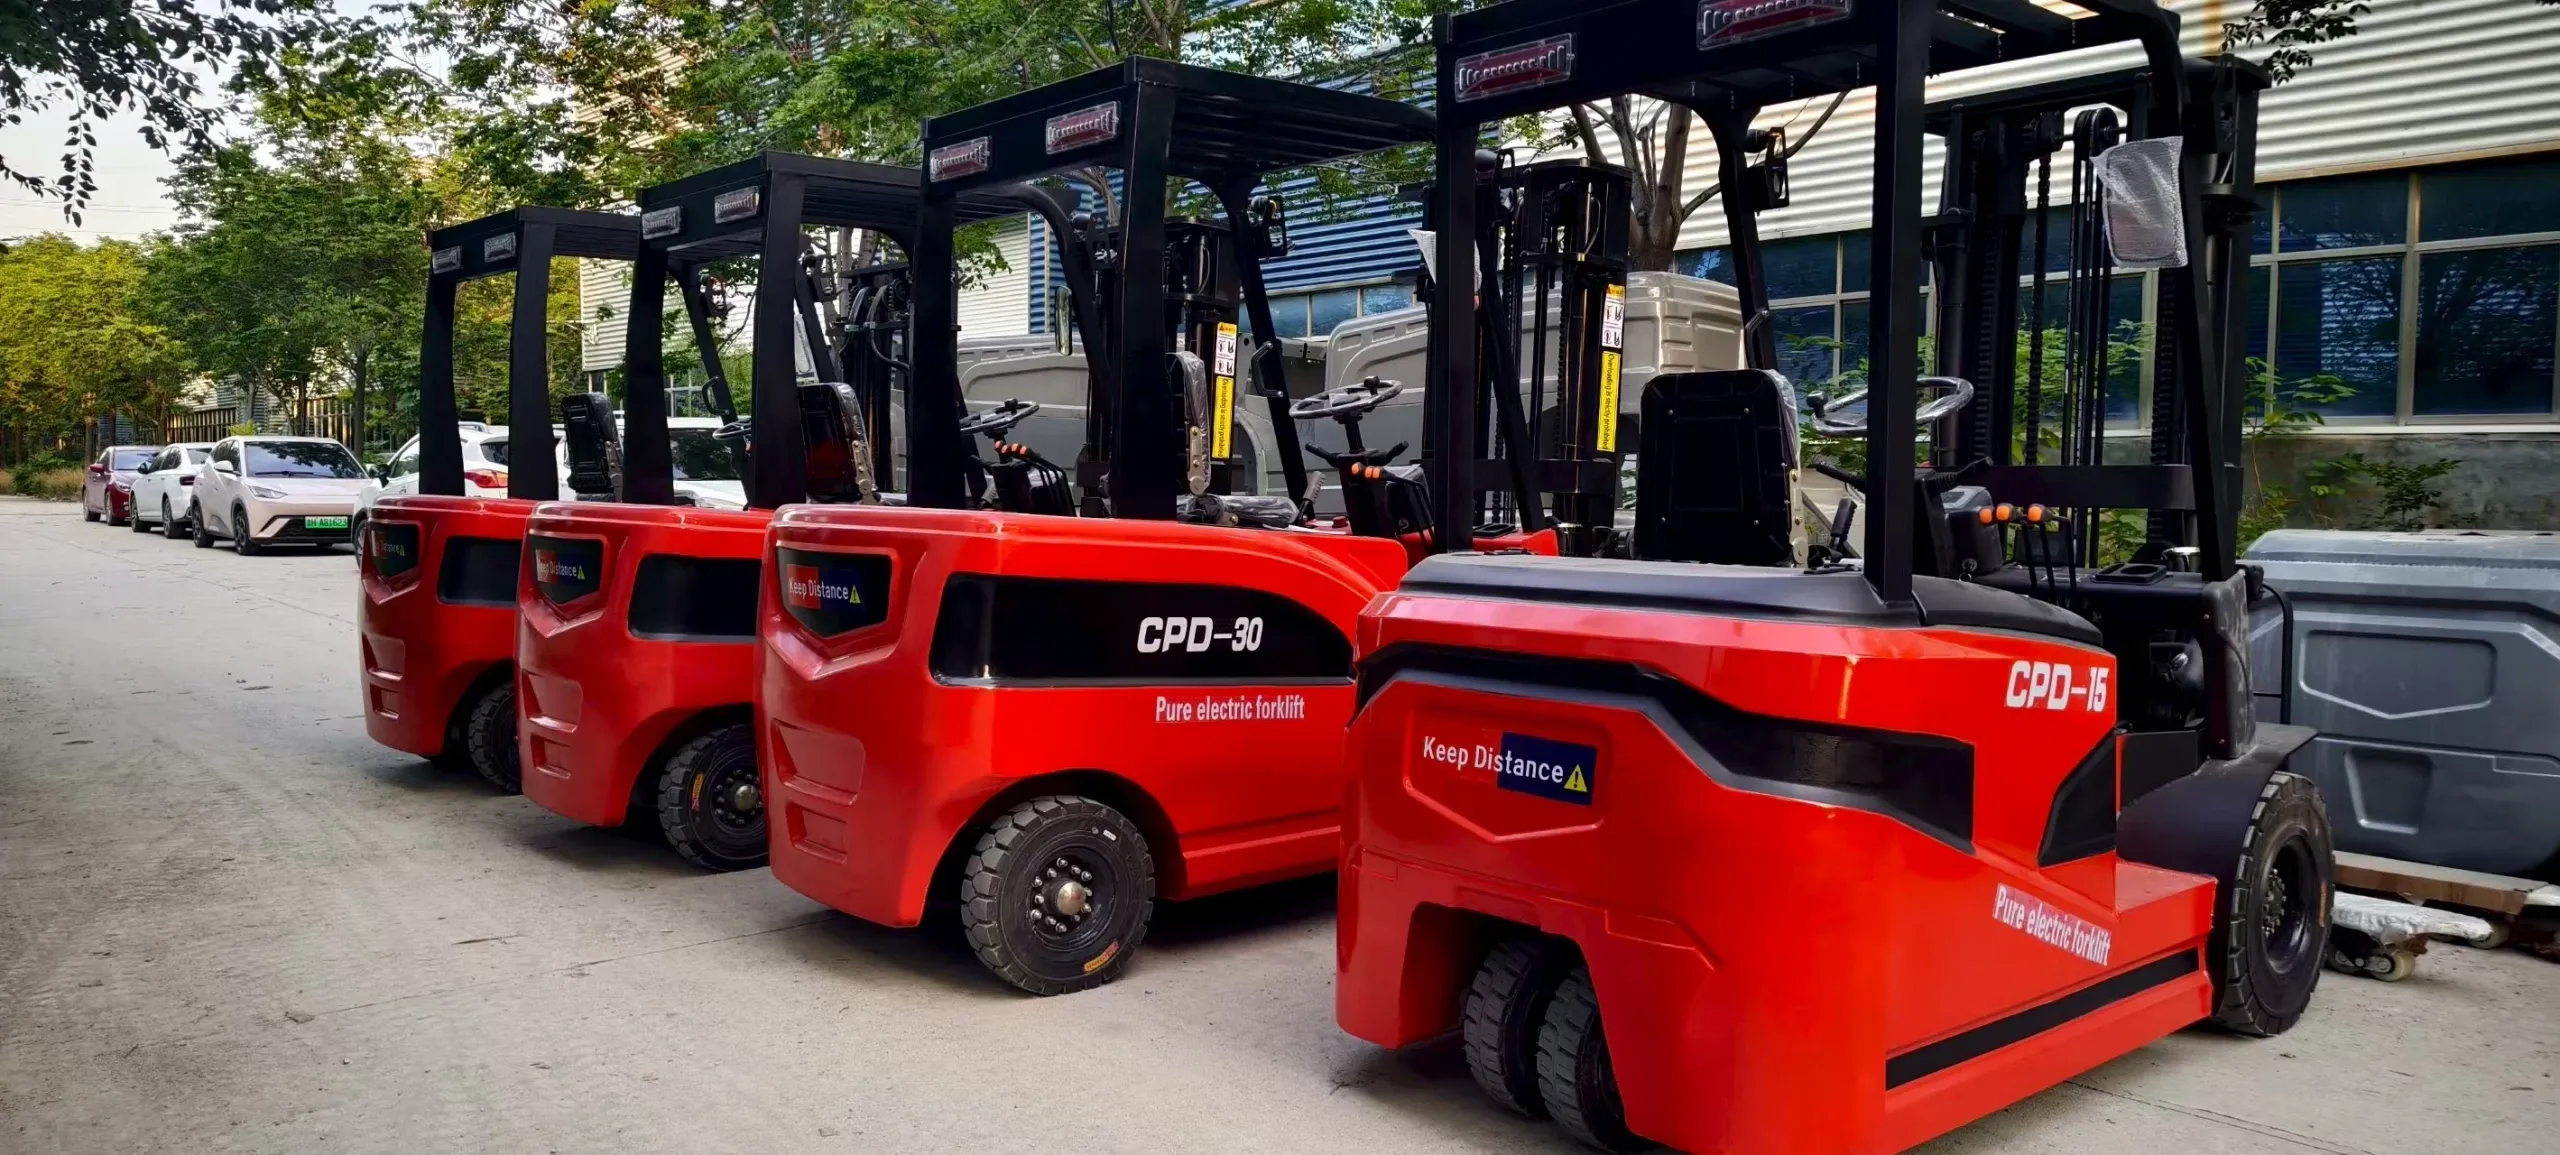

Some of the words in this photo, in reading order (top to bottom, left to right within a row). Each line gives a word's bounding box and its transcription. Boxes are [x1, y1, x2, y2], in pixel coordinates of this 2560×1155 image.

[550, 560, 577, 577] Distance
[788, 577, 807, 600] Keep
[808, 579, 848, 600] Distance
[1137, 616, 1264, 653] CPD-30
[2006, 660, 2109, 712] CPD-15
[1156, 696, 1192, 721] Pure
[1197, 696, 1252, 720] electric
[1256, 694, 1305, 719] forklift
[1423, 736, 1468, 771] Keep
[1474, 745, 1564, 783] Distance
[1994, 884, 2025, 930] Pure
[2027, 901, 2072, 950] electric
[2071, 919, 2111, 966] forklift
